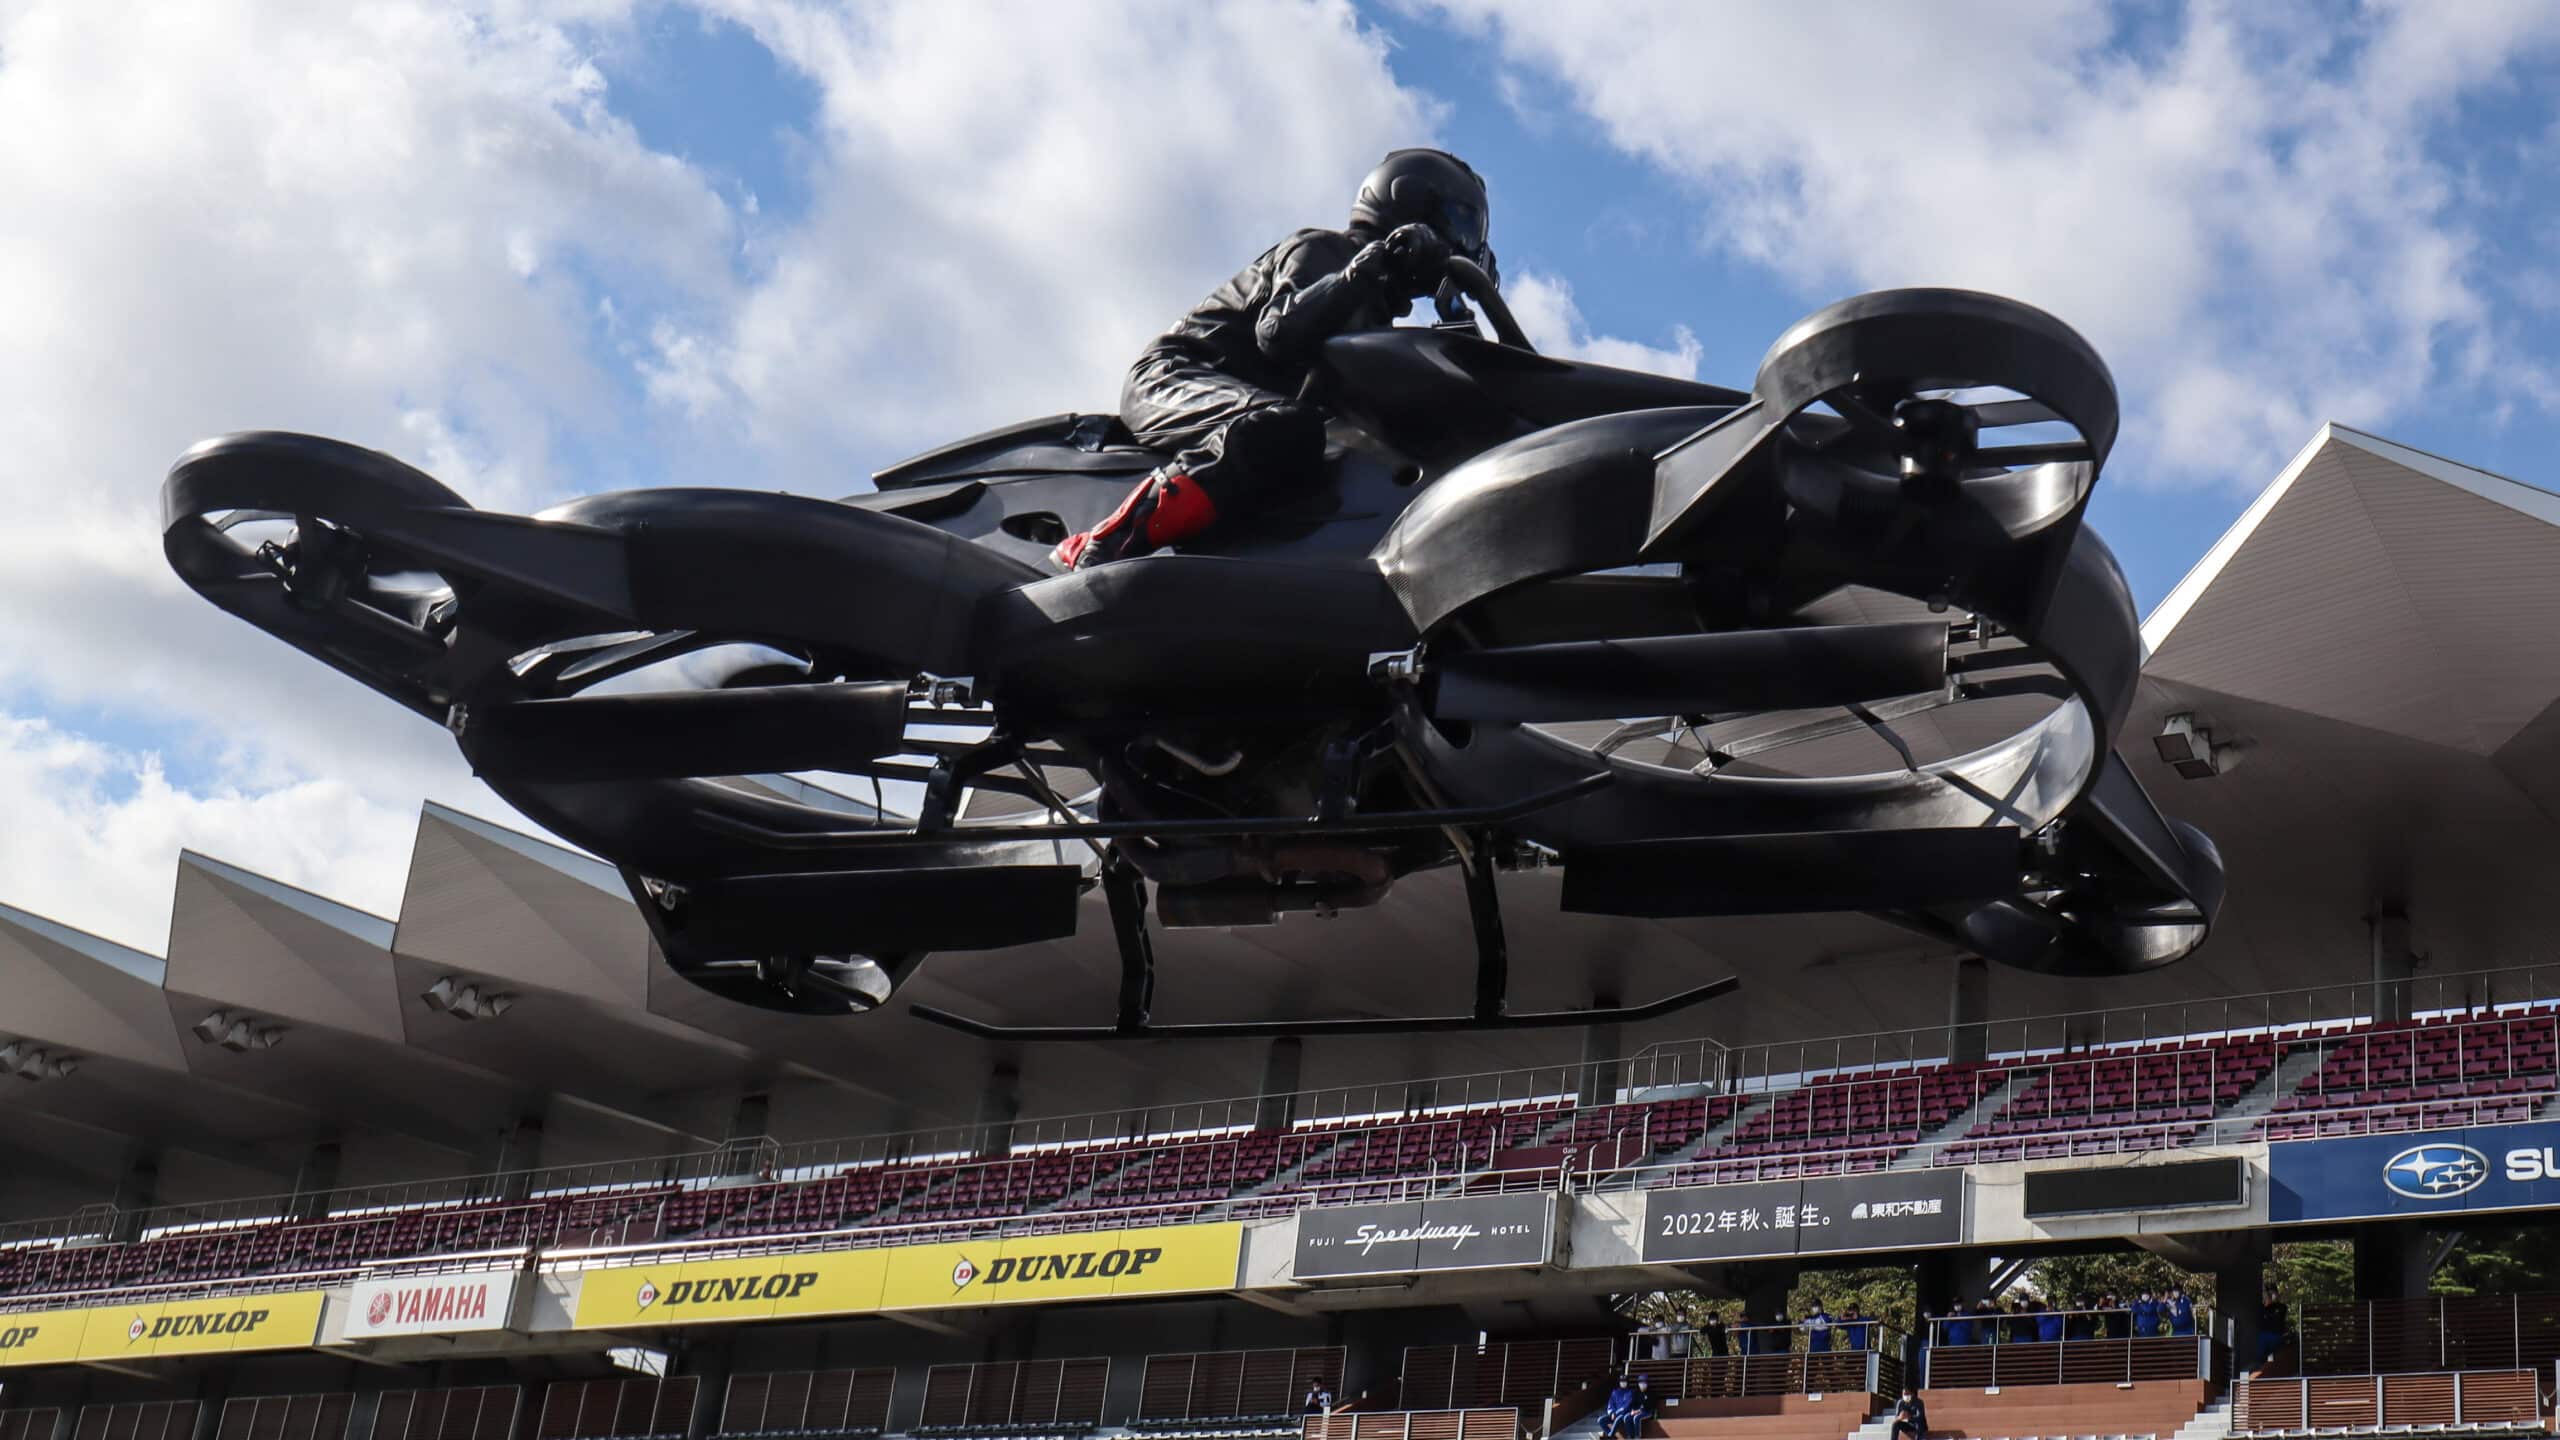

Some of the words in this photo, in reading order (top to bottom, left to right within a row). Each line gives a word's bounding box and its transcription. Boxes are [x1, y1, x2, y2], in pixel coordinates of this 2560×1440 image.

[1662, 1203, 1832, 1236] 2022年秋、誕生。
[1871, 1199, 1942, 1218] 東和不動産
[1309, 1237, 1335, 1248] FUJI
[1344, 1220, 1481, 1256] Speedway
[1491, 1224, 1531, 1235] HOTEL
[982, 1248, 1162, 1284] DUNLOP
[395, 1284, 488, 1324] YAMAHA
[662, 1272, 819, 1305] DUNLOP
[147, 1309, 270, 1339] DUNLOP
